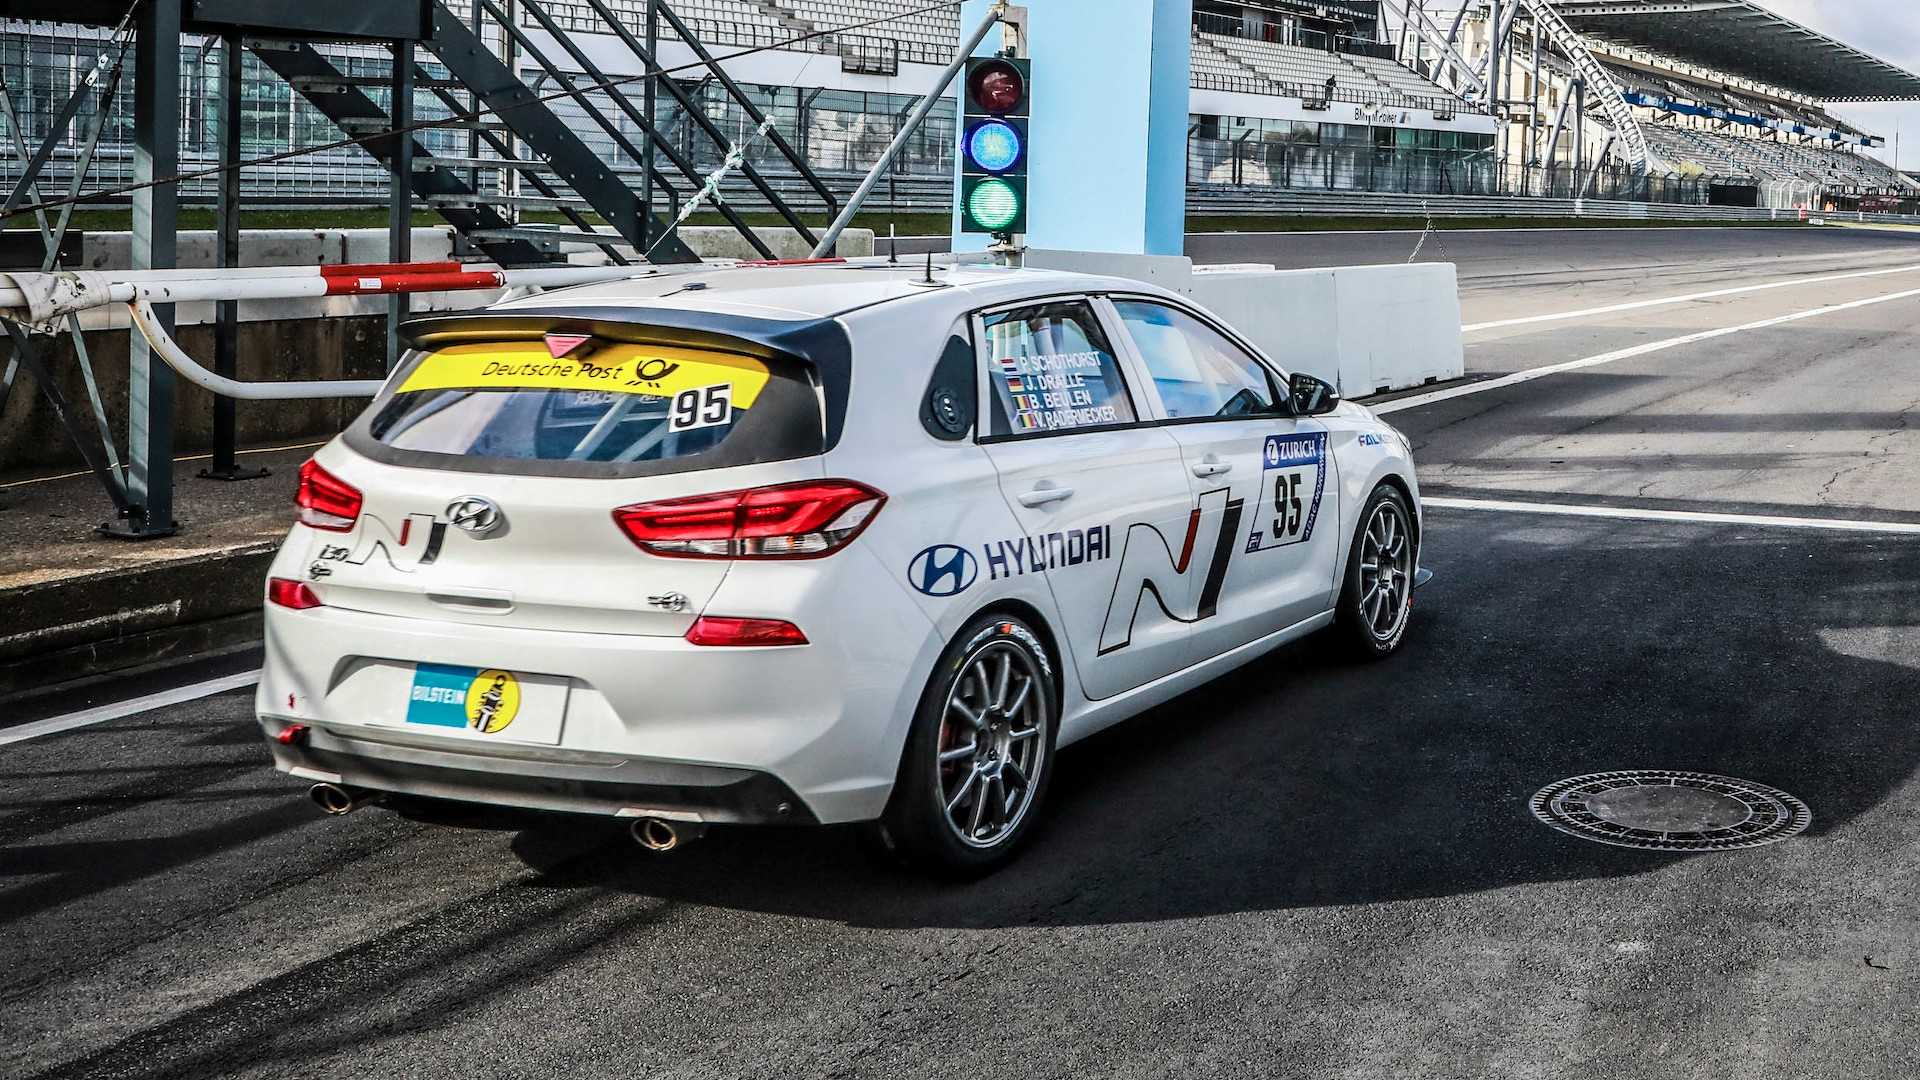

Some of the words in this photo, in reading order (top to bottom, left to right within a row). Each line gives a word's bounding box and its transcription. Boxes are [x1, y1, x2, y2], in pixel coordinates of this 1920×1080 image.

[481, 361, 573, 377] Deutsche
[575, 362, 624, 380] Post
[1020, 356, 1032, 373] P.
[1031, 351, 1102, 371] SCHOTHORST
[1026, 375, 1037, 391] J.
[1037, 372, 1086, 391] DRALLE
[674, 383, 731, 428] 95
[1028, 393, 1043, 409] B.
[1043, 389, 1093, 409] BEULEN
[1034, 411, 1046, 428] V.
[1045, 406, 1118, 428] RADERMECKER
[1280, 440, 1317, 460] ZURICH
[1272, 473, 1302, 539] 95
[984, 524, 1110, 581] HYUNDAI
[411, 685, 467, 705] BILSTEIN
